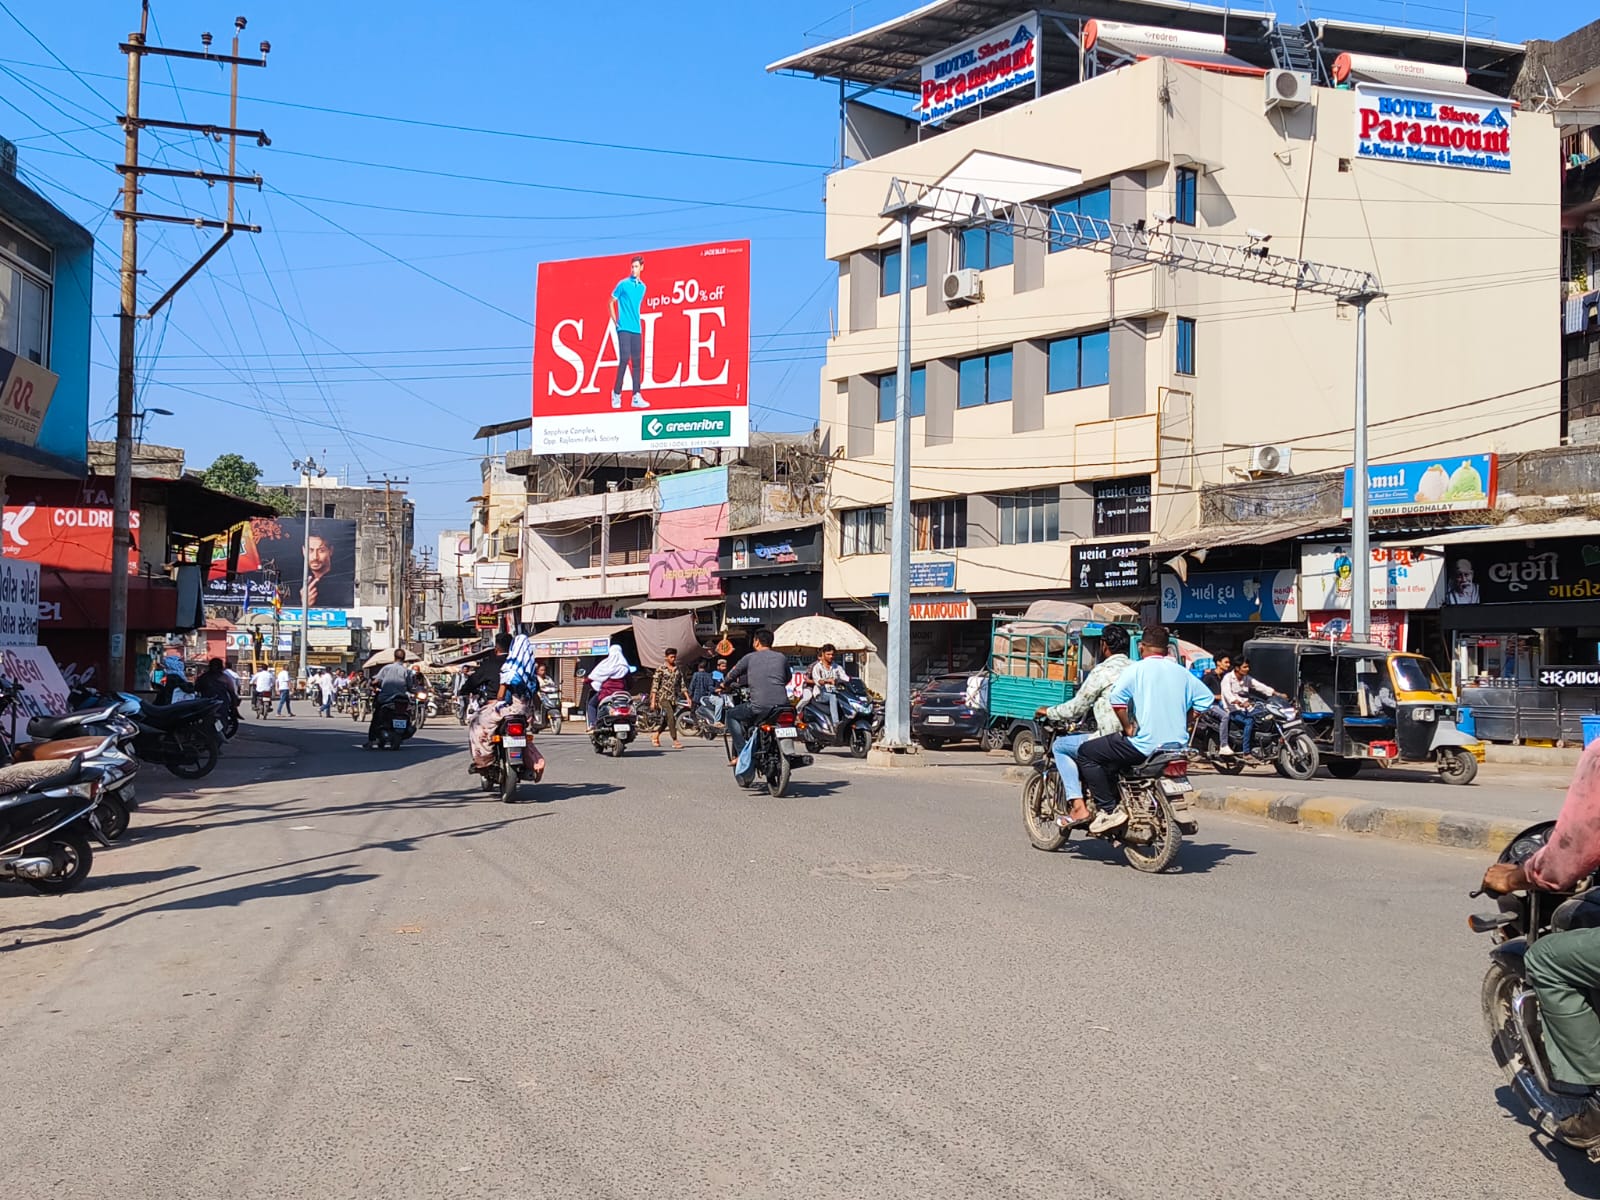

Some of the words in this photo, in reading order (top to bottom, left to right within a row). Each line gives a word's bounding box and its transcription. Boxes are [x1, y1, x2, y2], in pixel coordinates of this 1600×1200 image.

[934, 49, 977, 79] HOTEL
[977, 39, 1011, 60] Shree
[921, 38, 1035, 109] Paramount
[1378, 96, 1436, 119] HOTEL
[1438, 106, 1481, 124] Shree
[1359, 108, 1510, 155] Paramount
[647, 298, 660, 309] up
[661, 295, 670, 305] to
[709, 285, 725, 301] off
[548, 306, 730, 397] SALE
[83, 489, 114, 504] TA
[53, 508, 140, 529] COLDRIS
[1372, 507, 1399, 515] MOMAI
[1402, 503, 1453, 514] DUGDHALAY
[740, 589, 808, 610] SAMSUNG
[1192, 584, 1214, 600] માહી
[1217, 585, 1236, 605] દૂધ
[909, 602, 968, 619] ARAMOUNT
